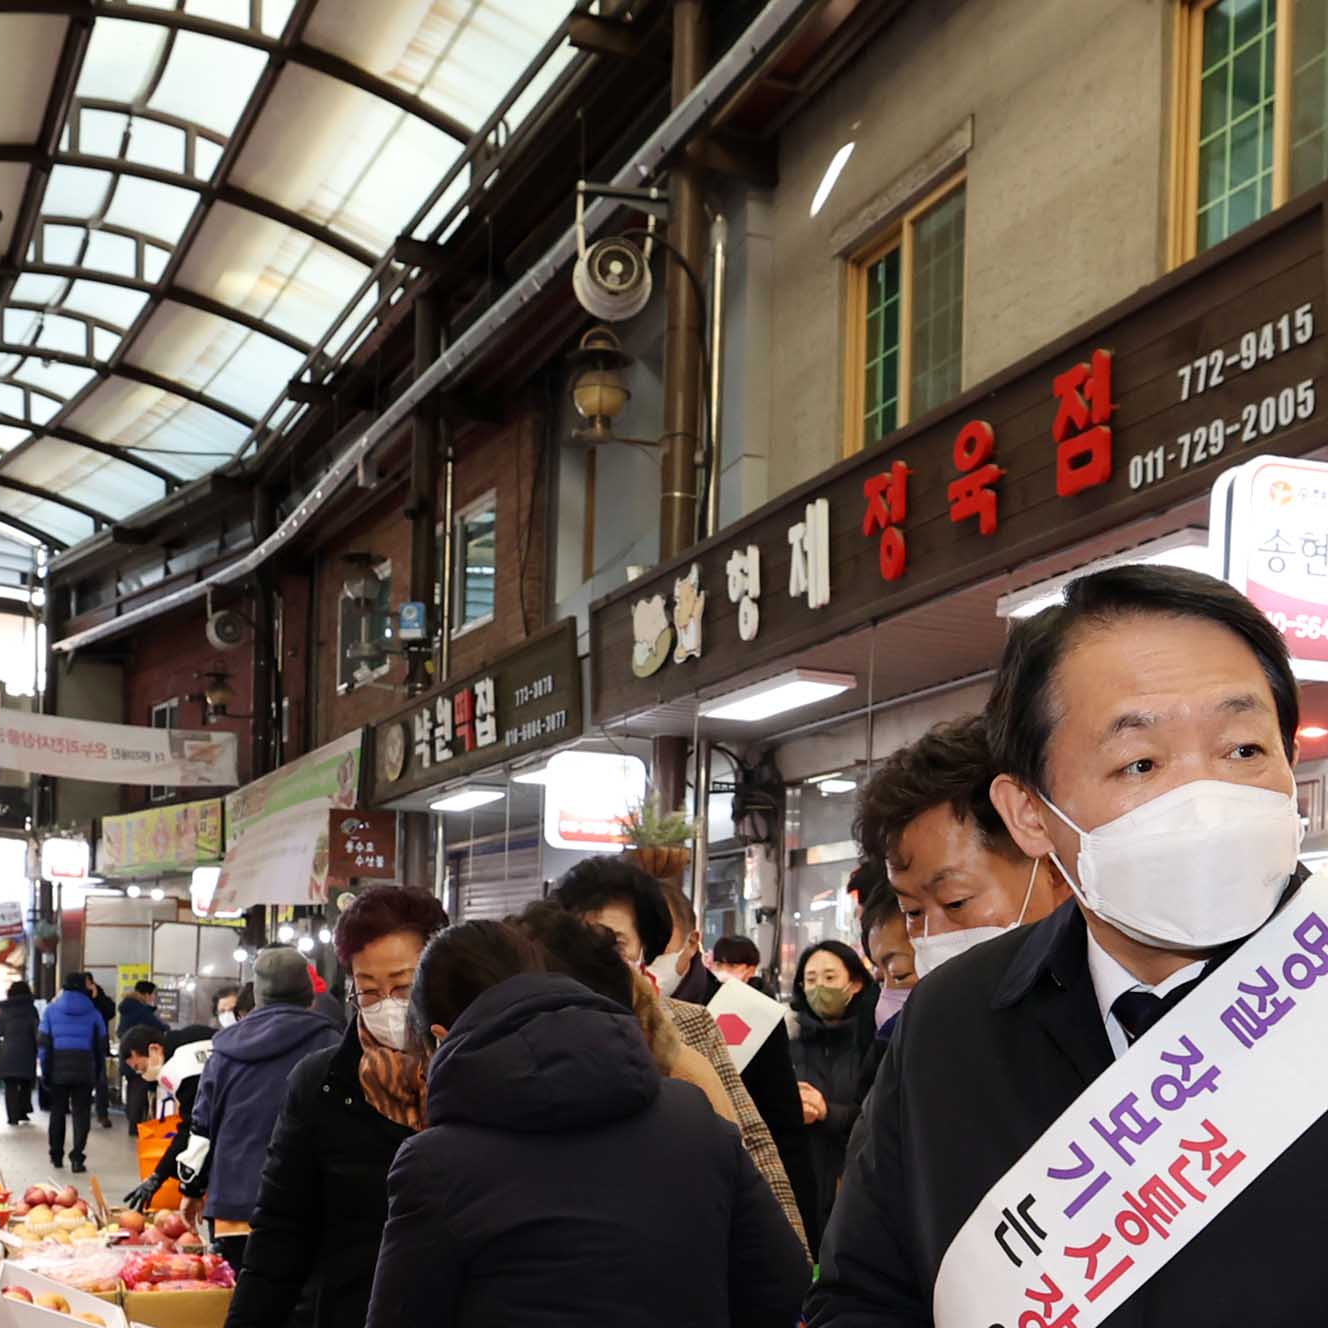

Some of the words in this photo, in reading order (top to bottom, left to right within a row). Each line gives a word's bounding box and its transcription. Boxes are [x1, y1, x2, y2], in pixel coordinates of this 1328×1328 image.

[1178, 302, 1316, 402] 772-9415
[1128, 379, 1317, 491] 011-729-2005
[725, 497, 831, 643] 형제
[862, 347, 1120, 583] 정육점
